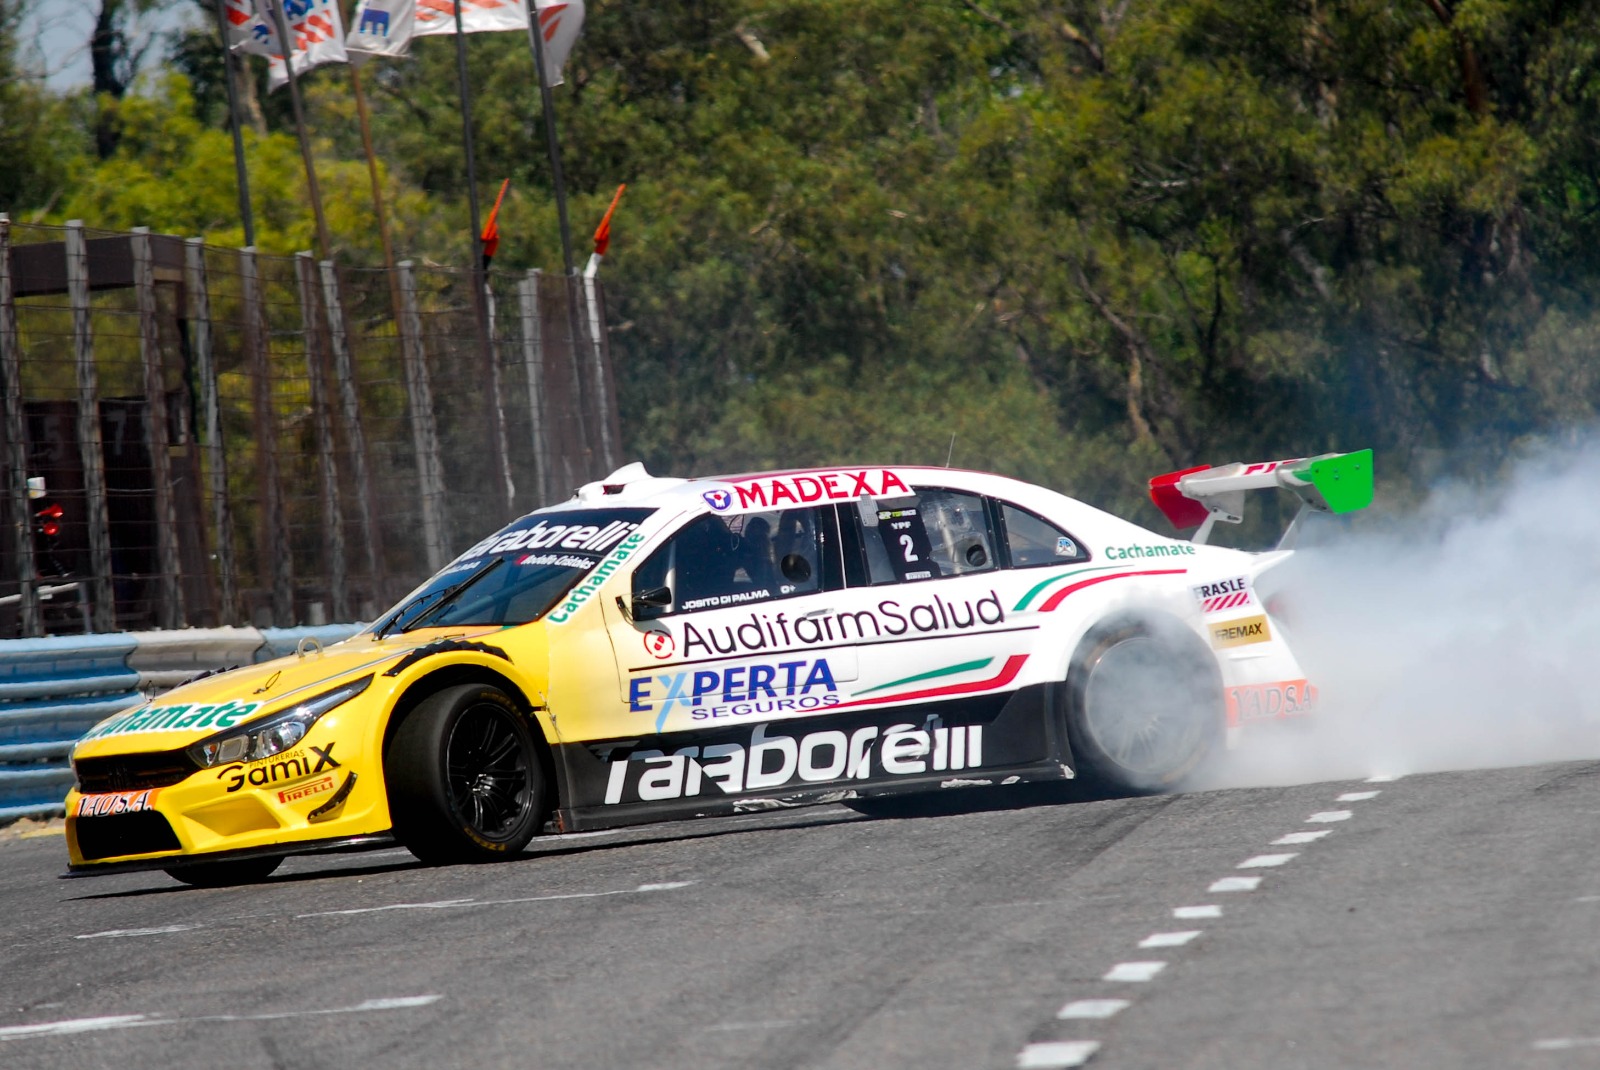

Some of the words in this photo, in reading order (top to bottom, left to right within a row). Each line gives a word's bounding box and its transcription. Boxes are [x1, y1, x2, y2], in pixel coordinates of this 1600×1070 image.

[733, 470, 909, 509] MADEXA
[459, 520, 640, 562] araborelli
[899, 534, 919, 562] 2
[1105, 544, 1196, 561] Cachamate
[547, 533, 645, 623] Cachamate
[682, 596, 720, 610] JOSITO
[720, 594, 732, 605] DI
[731, 589, 770, 603] PALMA
[683, 589, 1005, 658] AudifarmSalud
[629, 658, 838, 733] EXPERTA
[691, 694, 840, 721] SEGUROS
[82, 701, 260, 740] hamate
[249, 749, 306, 769] PINTURERIAS
[277, 776, 335, 804] PIRELLI
